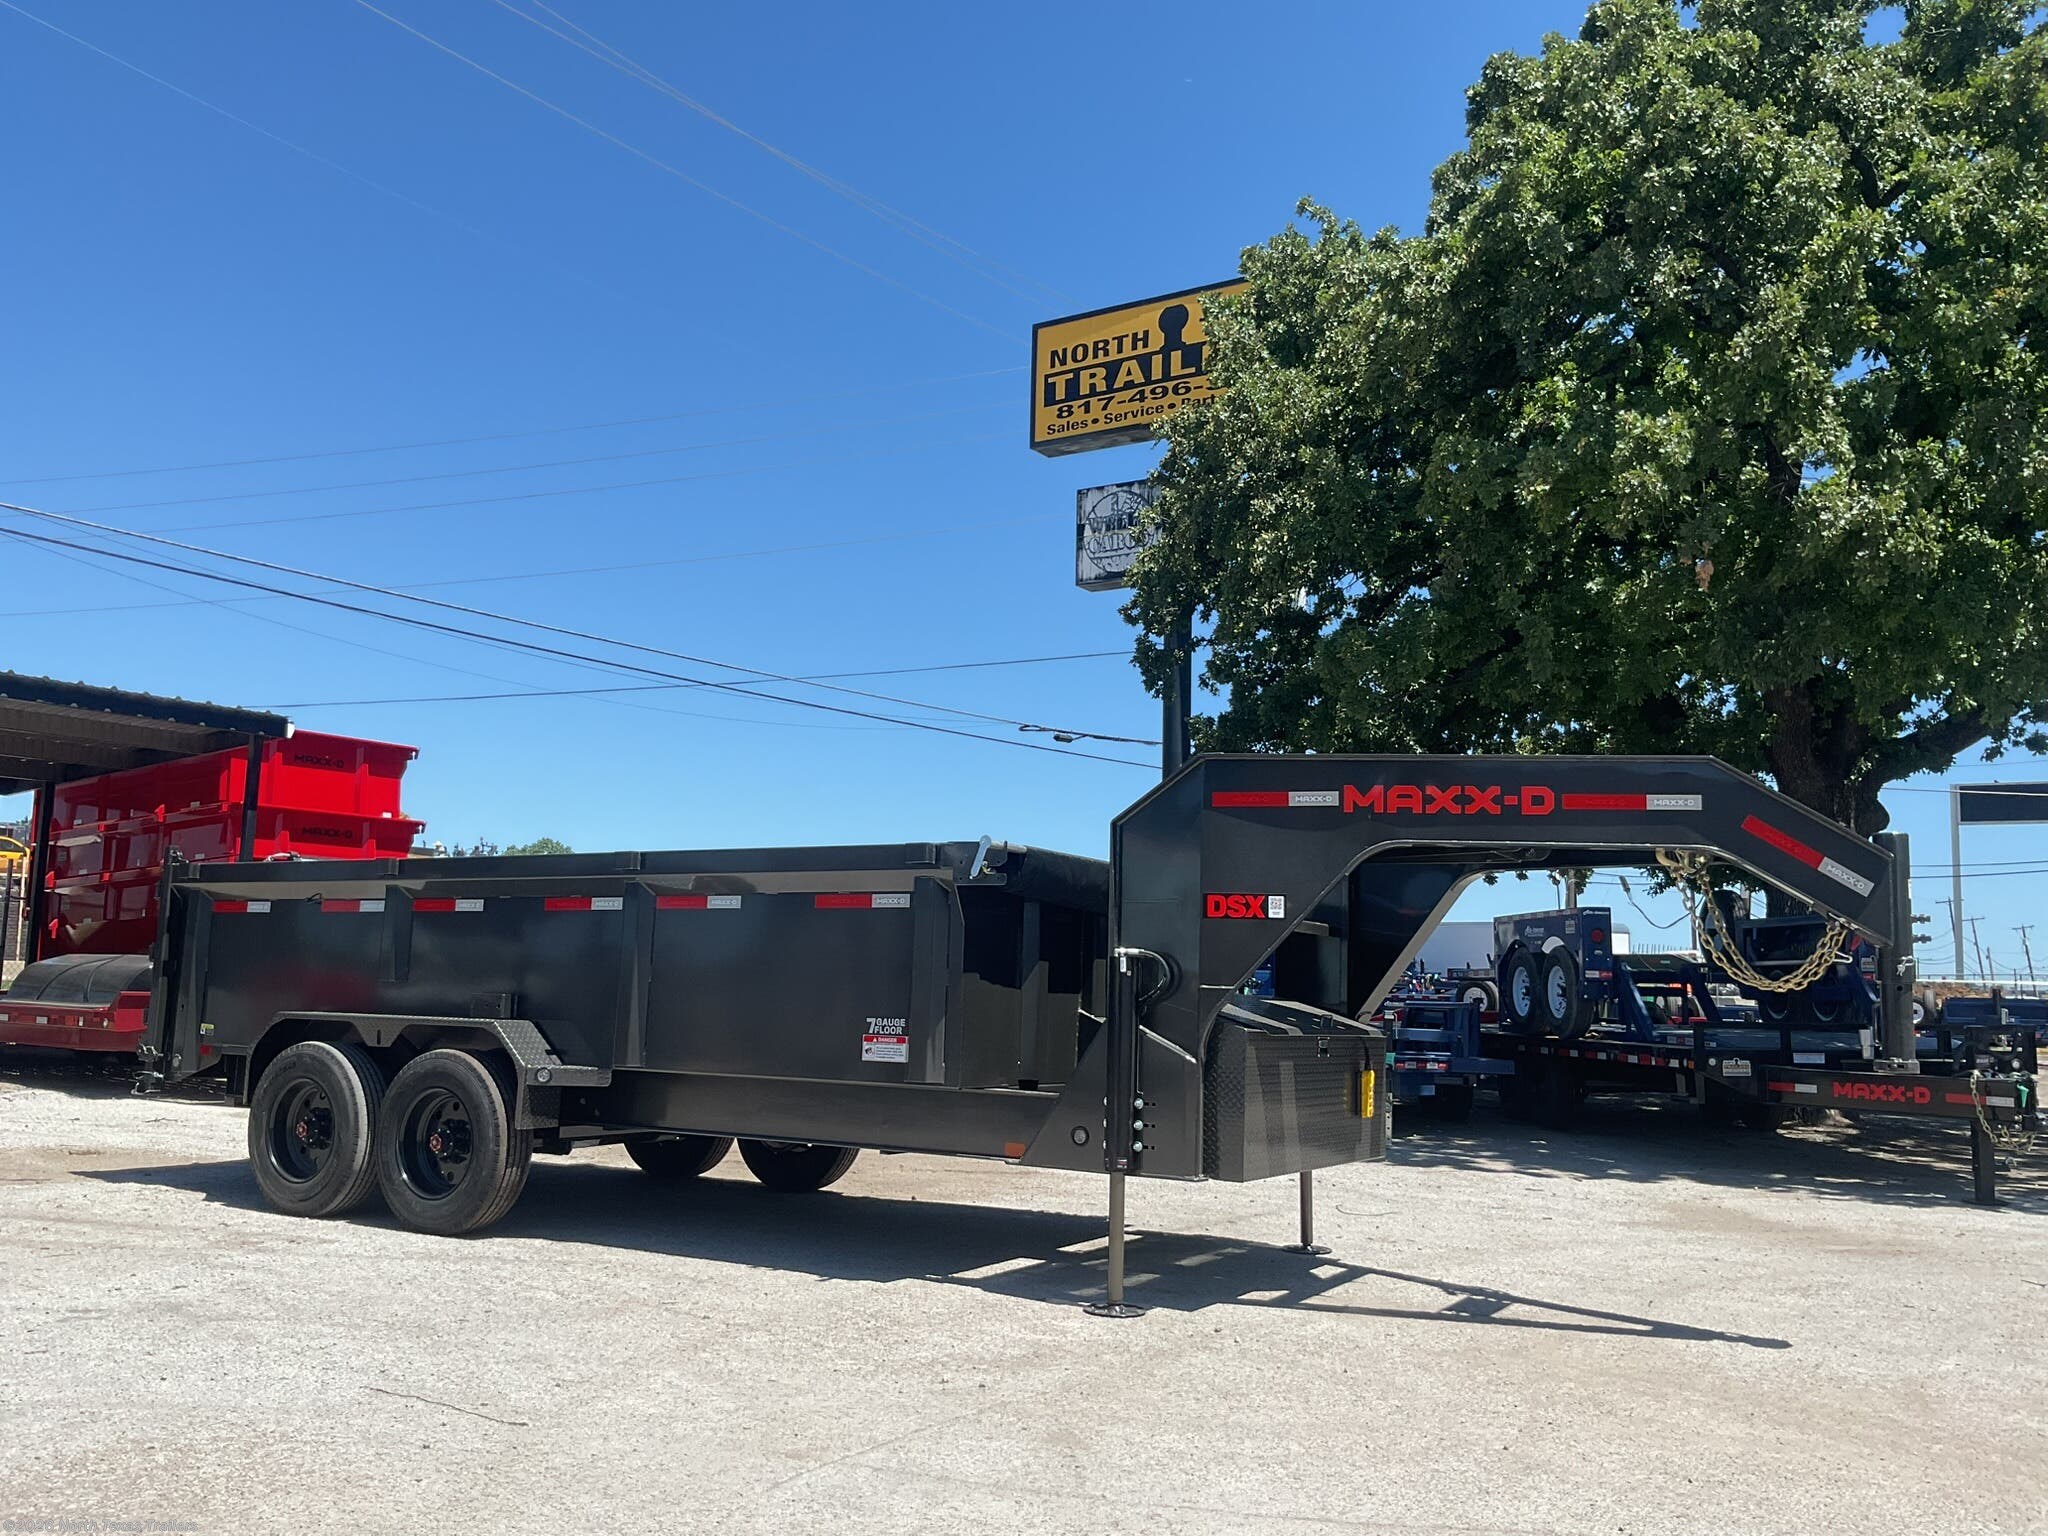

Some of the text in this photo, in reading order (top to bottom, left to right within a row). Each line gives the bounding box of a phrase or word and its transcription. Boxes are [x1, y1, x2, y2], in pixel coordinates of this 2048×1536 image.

[1050, 329, 1150, 369] NORTH
[1047, 346, 1210, 401] TRAIL
[1047, 393, 1220, 435] Sales Service Part
[1295, 795, 1333, 803] MAXX-D
[1343, 784, 1555, 815] MAXX-D
[1653, 799, 1696, 807] MAXX-D
[1826, 864, 1866, 890] MAXX-D
[1206, 894, 1266, 918] DSX
[866, 1017, 906, 1034] 7 GAUGE
[874, 1025, 903, 1034] FLOOR
[1832, 1081, 1932, 1105] MAXX-D
